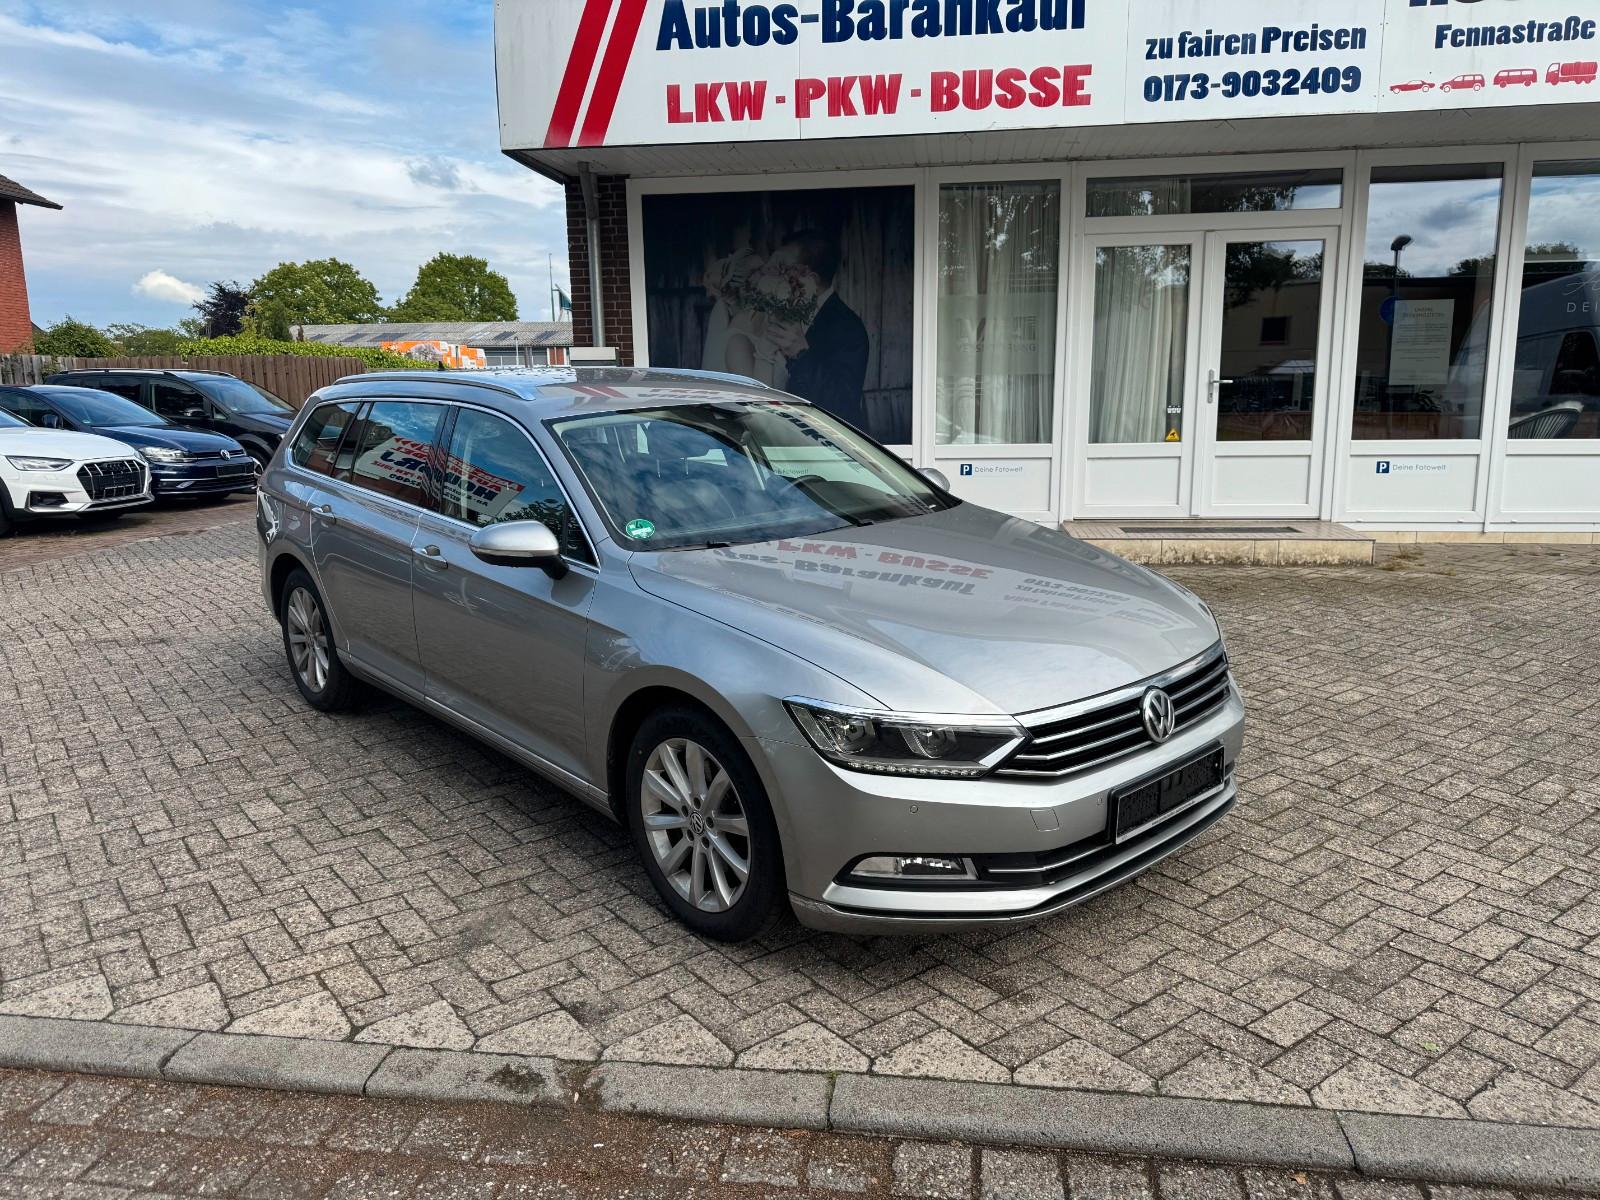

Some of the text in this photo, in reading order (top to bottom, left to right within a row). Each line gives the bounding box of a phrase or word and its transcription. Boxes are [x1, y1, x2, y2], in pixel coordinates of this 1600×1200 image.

[1145, 23, 1367, 60] zu fairen Preisen
[1434, 15, 1597, 49] Fennastraße
[666, 80, 768, 123] LKW
[795, 73, 903, 119] PKW
[930, 64, 1093, 112] BUSSE
[1143, 65, 1362, 102] 0173-9032409
